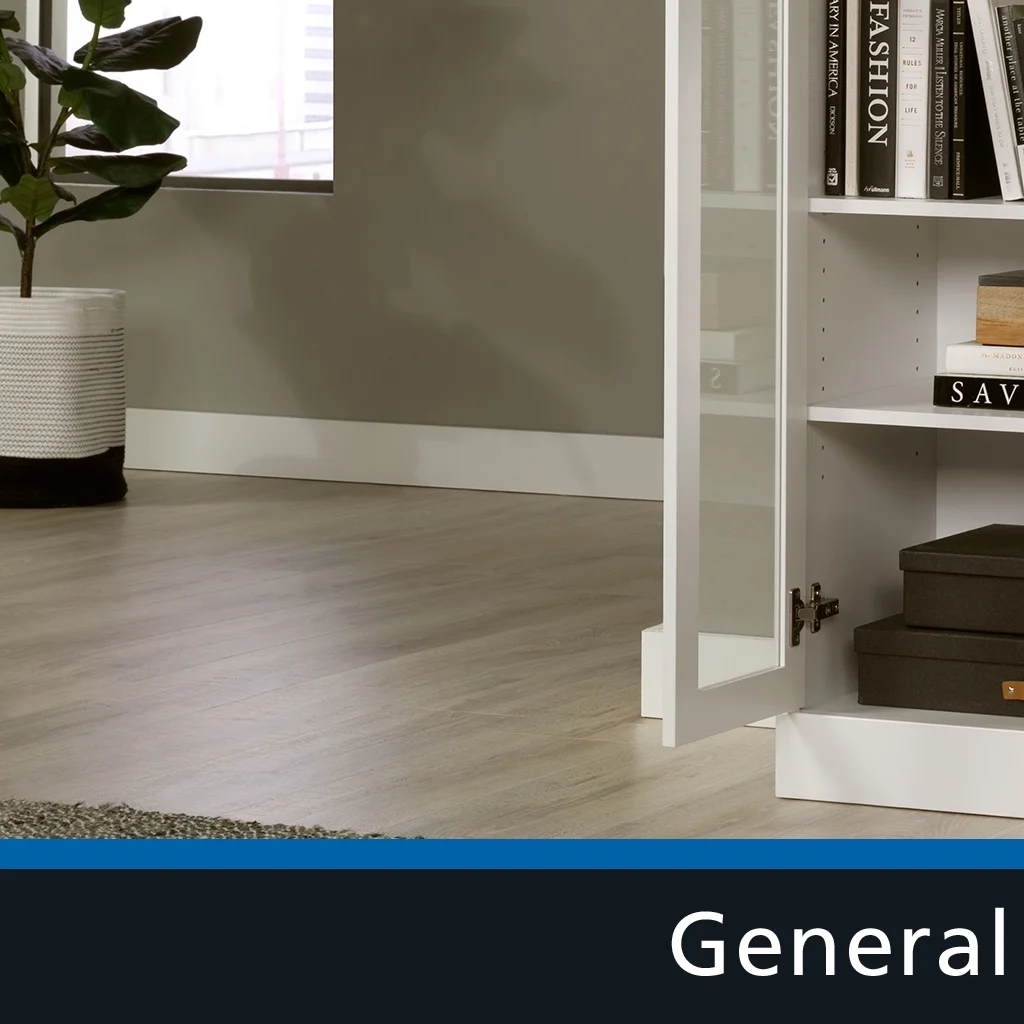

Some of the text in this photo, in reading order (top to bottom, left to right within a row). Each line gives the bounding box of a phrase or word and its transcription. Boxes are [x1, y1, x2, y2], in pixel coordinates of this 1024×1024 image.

[829, 23, 839, 37] IN
[1002, 15, 1013, 51] another
[935, 37, 945, 65] MULLER
[828, 40, 839, 98] AMERICA
[868, 0, 890, 146] FASHION
[1006, 55, 1017, 81] place
[935, 71, 947, 98] LISTEN
[1012, 85, 1019, 94] at
[935, 99, 944, 112] TO
[1014, 98, 1023, 113] the
[935, 112, 944, 128] THE
[935, 131, 946, 166] SILENCE
